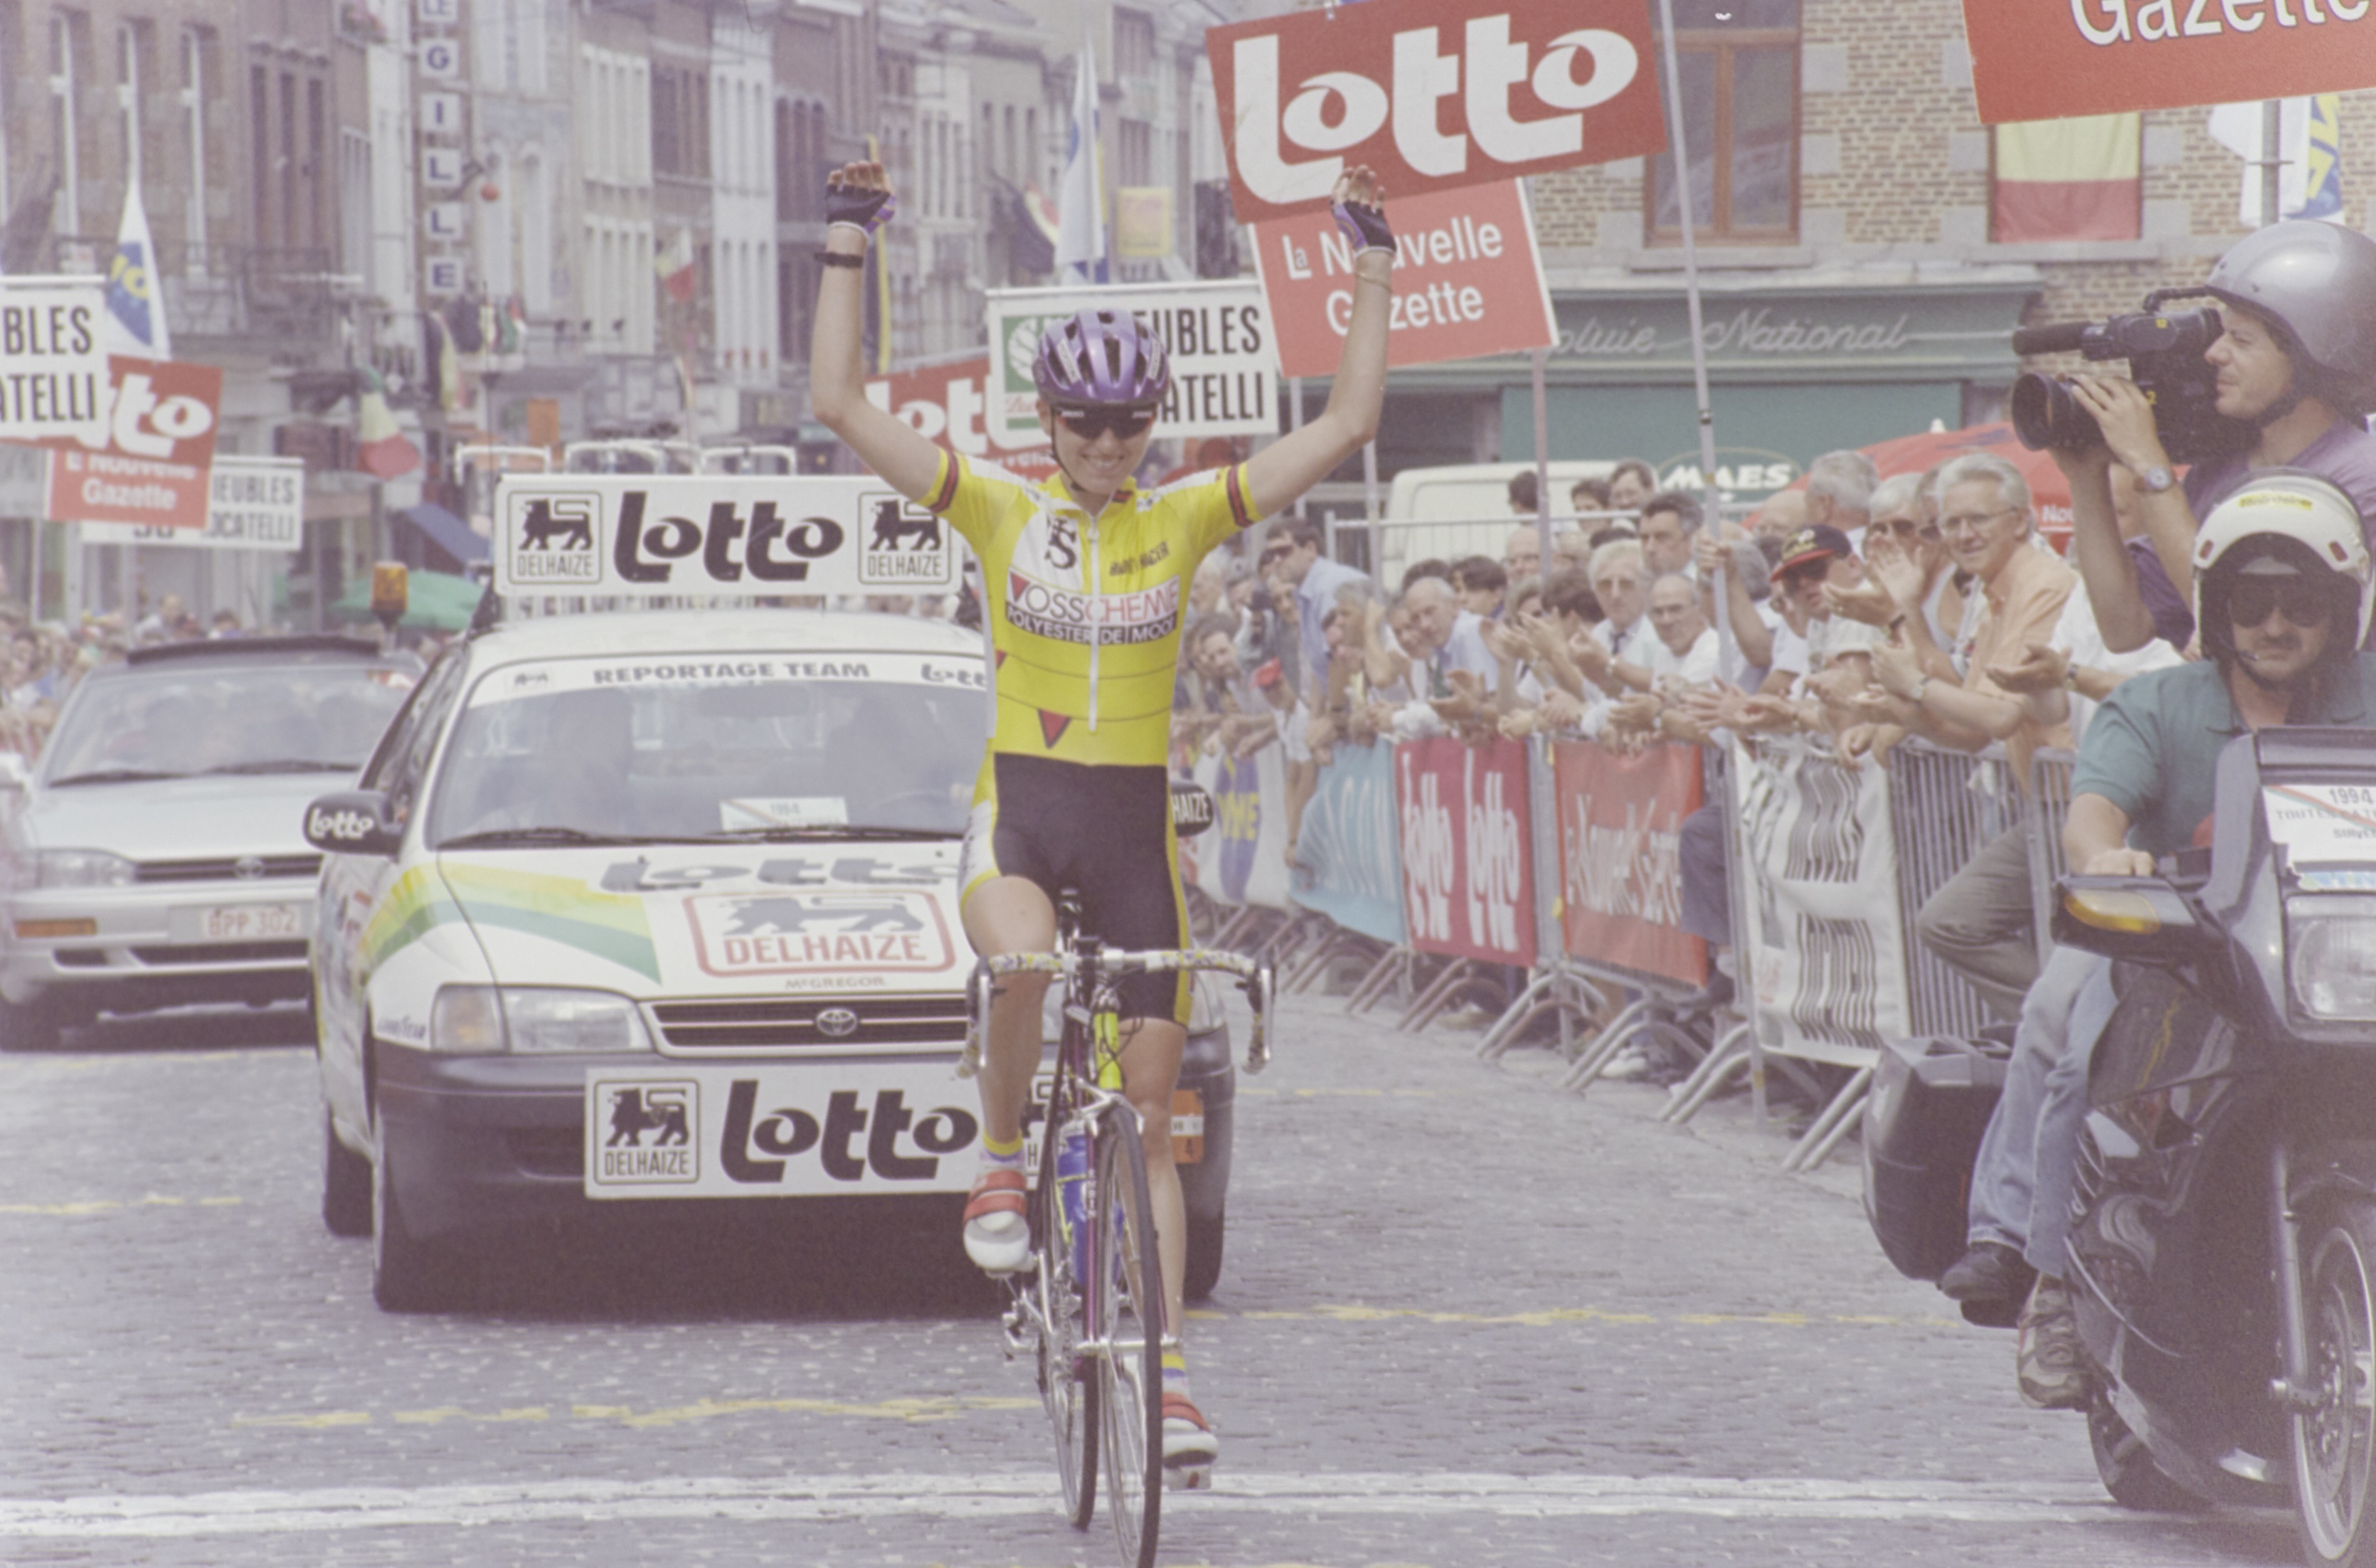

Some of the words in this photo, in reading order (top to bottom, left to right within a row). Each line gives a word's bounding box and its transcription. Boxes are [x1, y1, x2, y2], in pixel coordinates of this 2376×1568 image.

[427, 46, 456, 286] GILLE
[1320, 215, 1503, 277] Nvelle
[1326, 282, 1484, 337] Gzette
[4, 306, 93, 355] BLES
[1140, 306, 1261, 356] UBLES
[1704, 307, 1909, 352] National
[107, 373, 213, 458] to
[213, 475, 295, 505] EUBLES
[1662, 464, 1791, 490] MAES
[82, 477, 178, 512] Gazette
[203, 512, 295, 541] CATELLI
[517, 555, 593, 578] DELHAIZE
[868, 555, 942, 578] DELHAIZE
[1102, 627, 1124, 642] DE
[593, 662, 774, 684] REPORTAGE
[783, 662, 871, 679] TEAM
[921, 663, 986, 687] Lott
[1172, 793, 1209, 825] HAIZE
[2329, 788, 2373, 805] 1994
[723, 935, 927, 965] DELHAIZE
[605, 1150, 689, 1176] DELHAIZE
